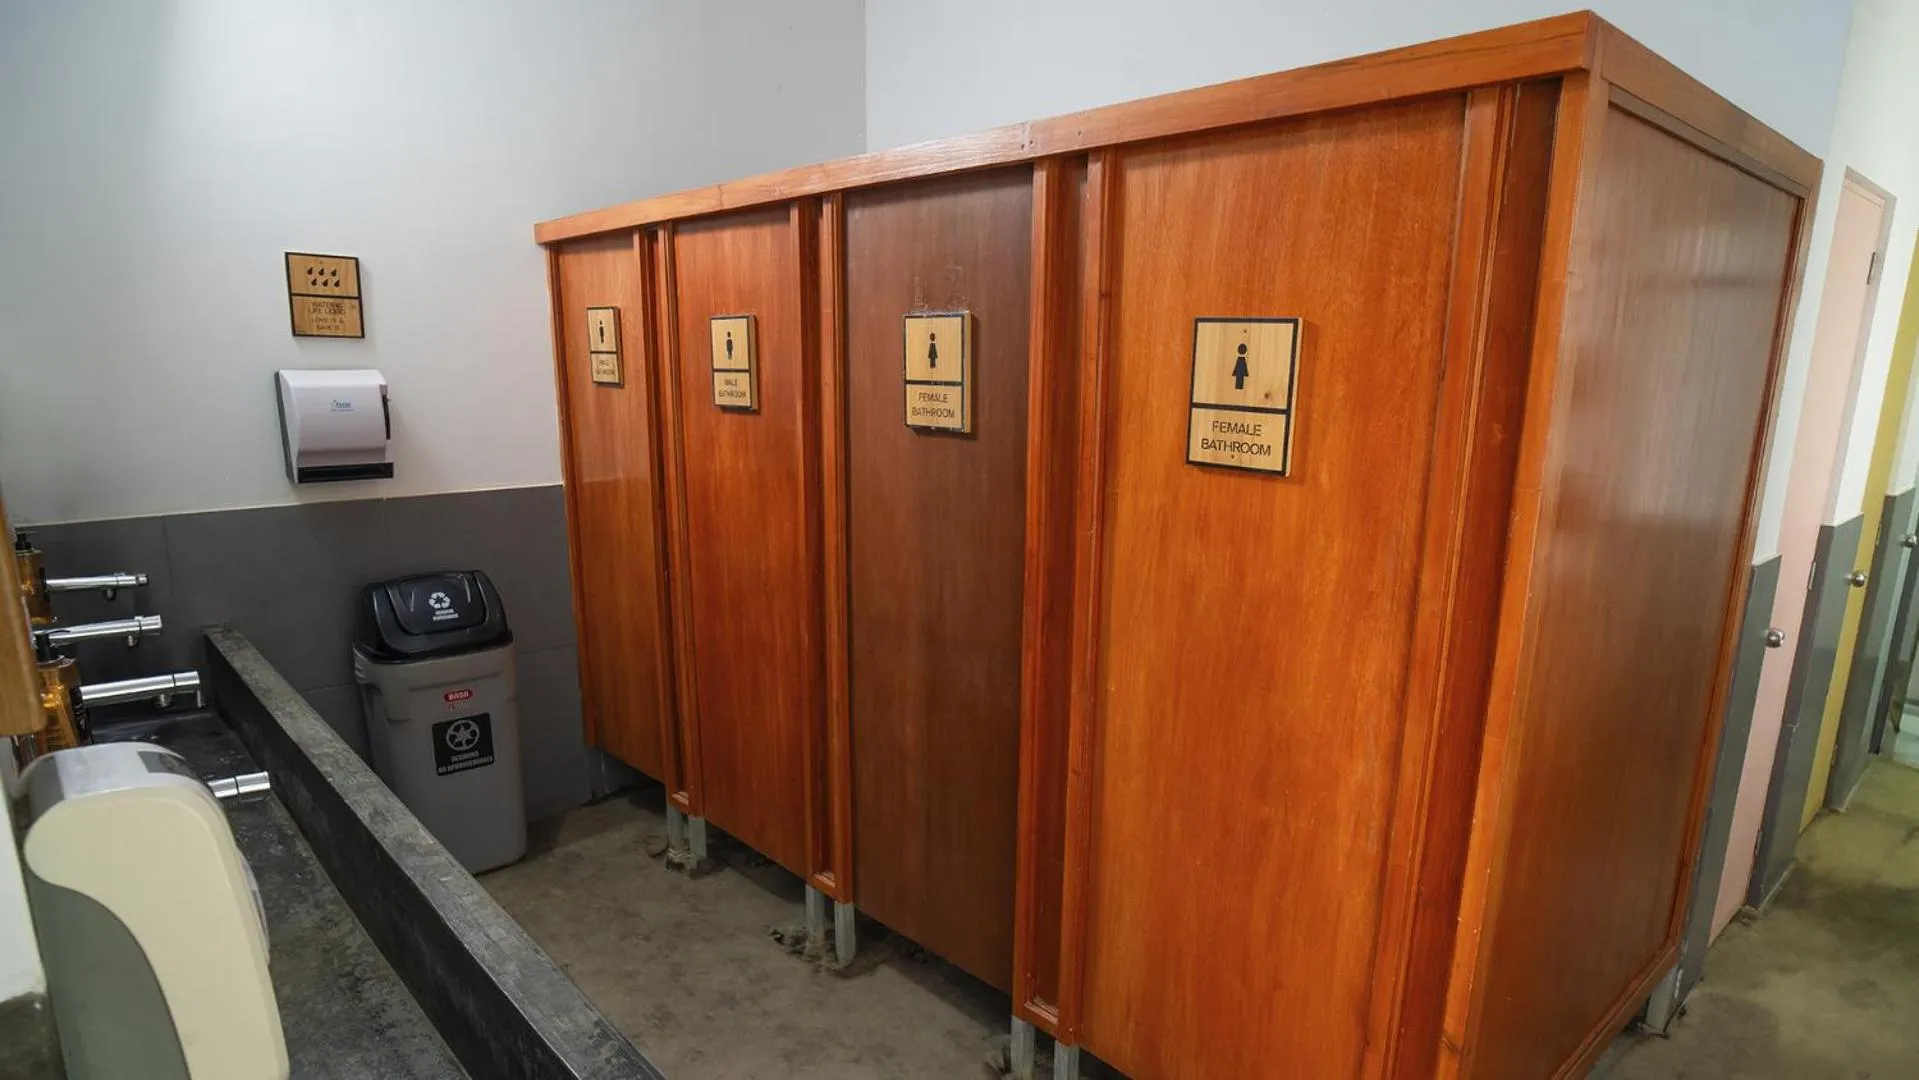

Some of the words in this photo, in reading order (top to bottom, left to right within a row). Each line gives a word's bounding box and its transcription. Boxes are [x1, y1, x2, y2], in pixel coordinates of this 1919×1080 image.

[918, 392, 949, 404] FEMALE
[911, 406, 956, 419] BATHROOM
[1212, 420, 1263, 437] FEMALE
[1200, 438, 1272, 457] BATHROOM
